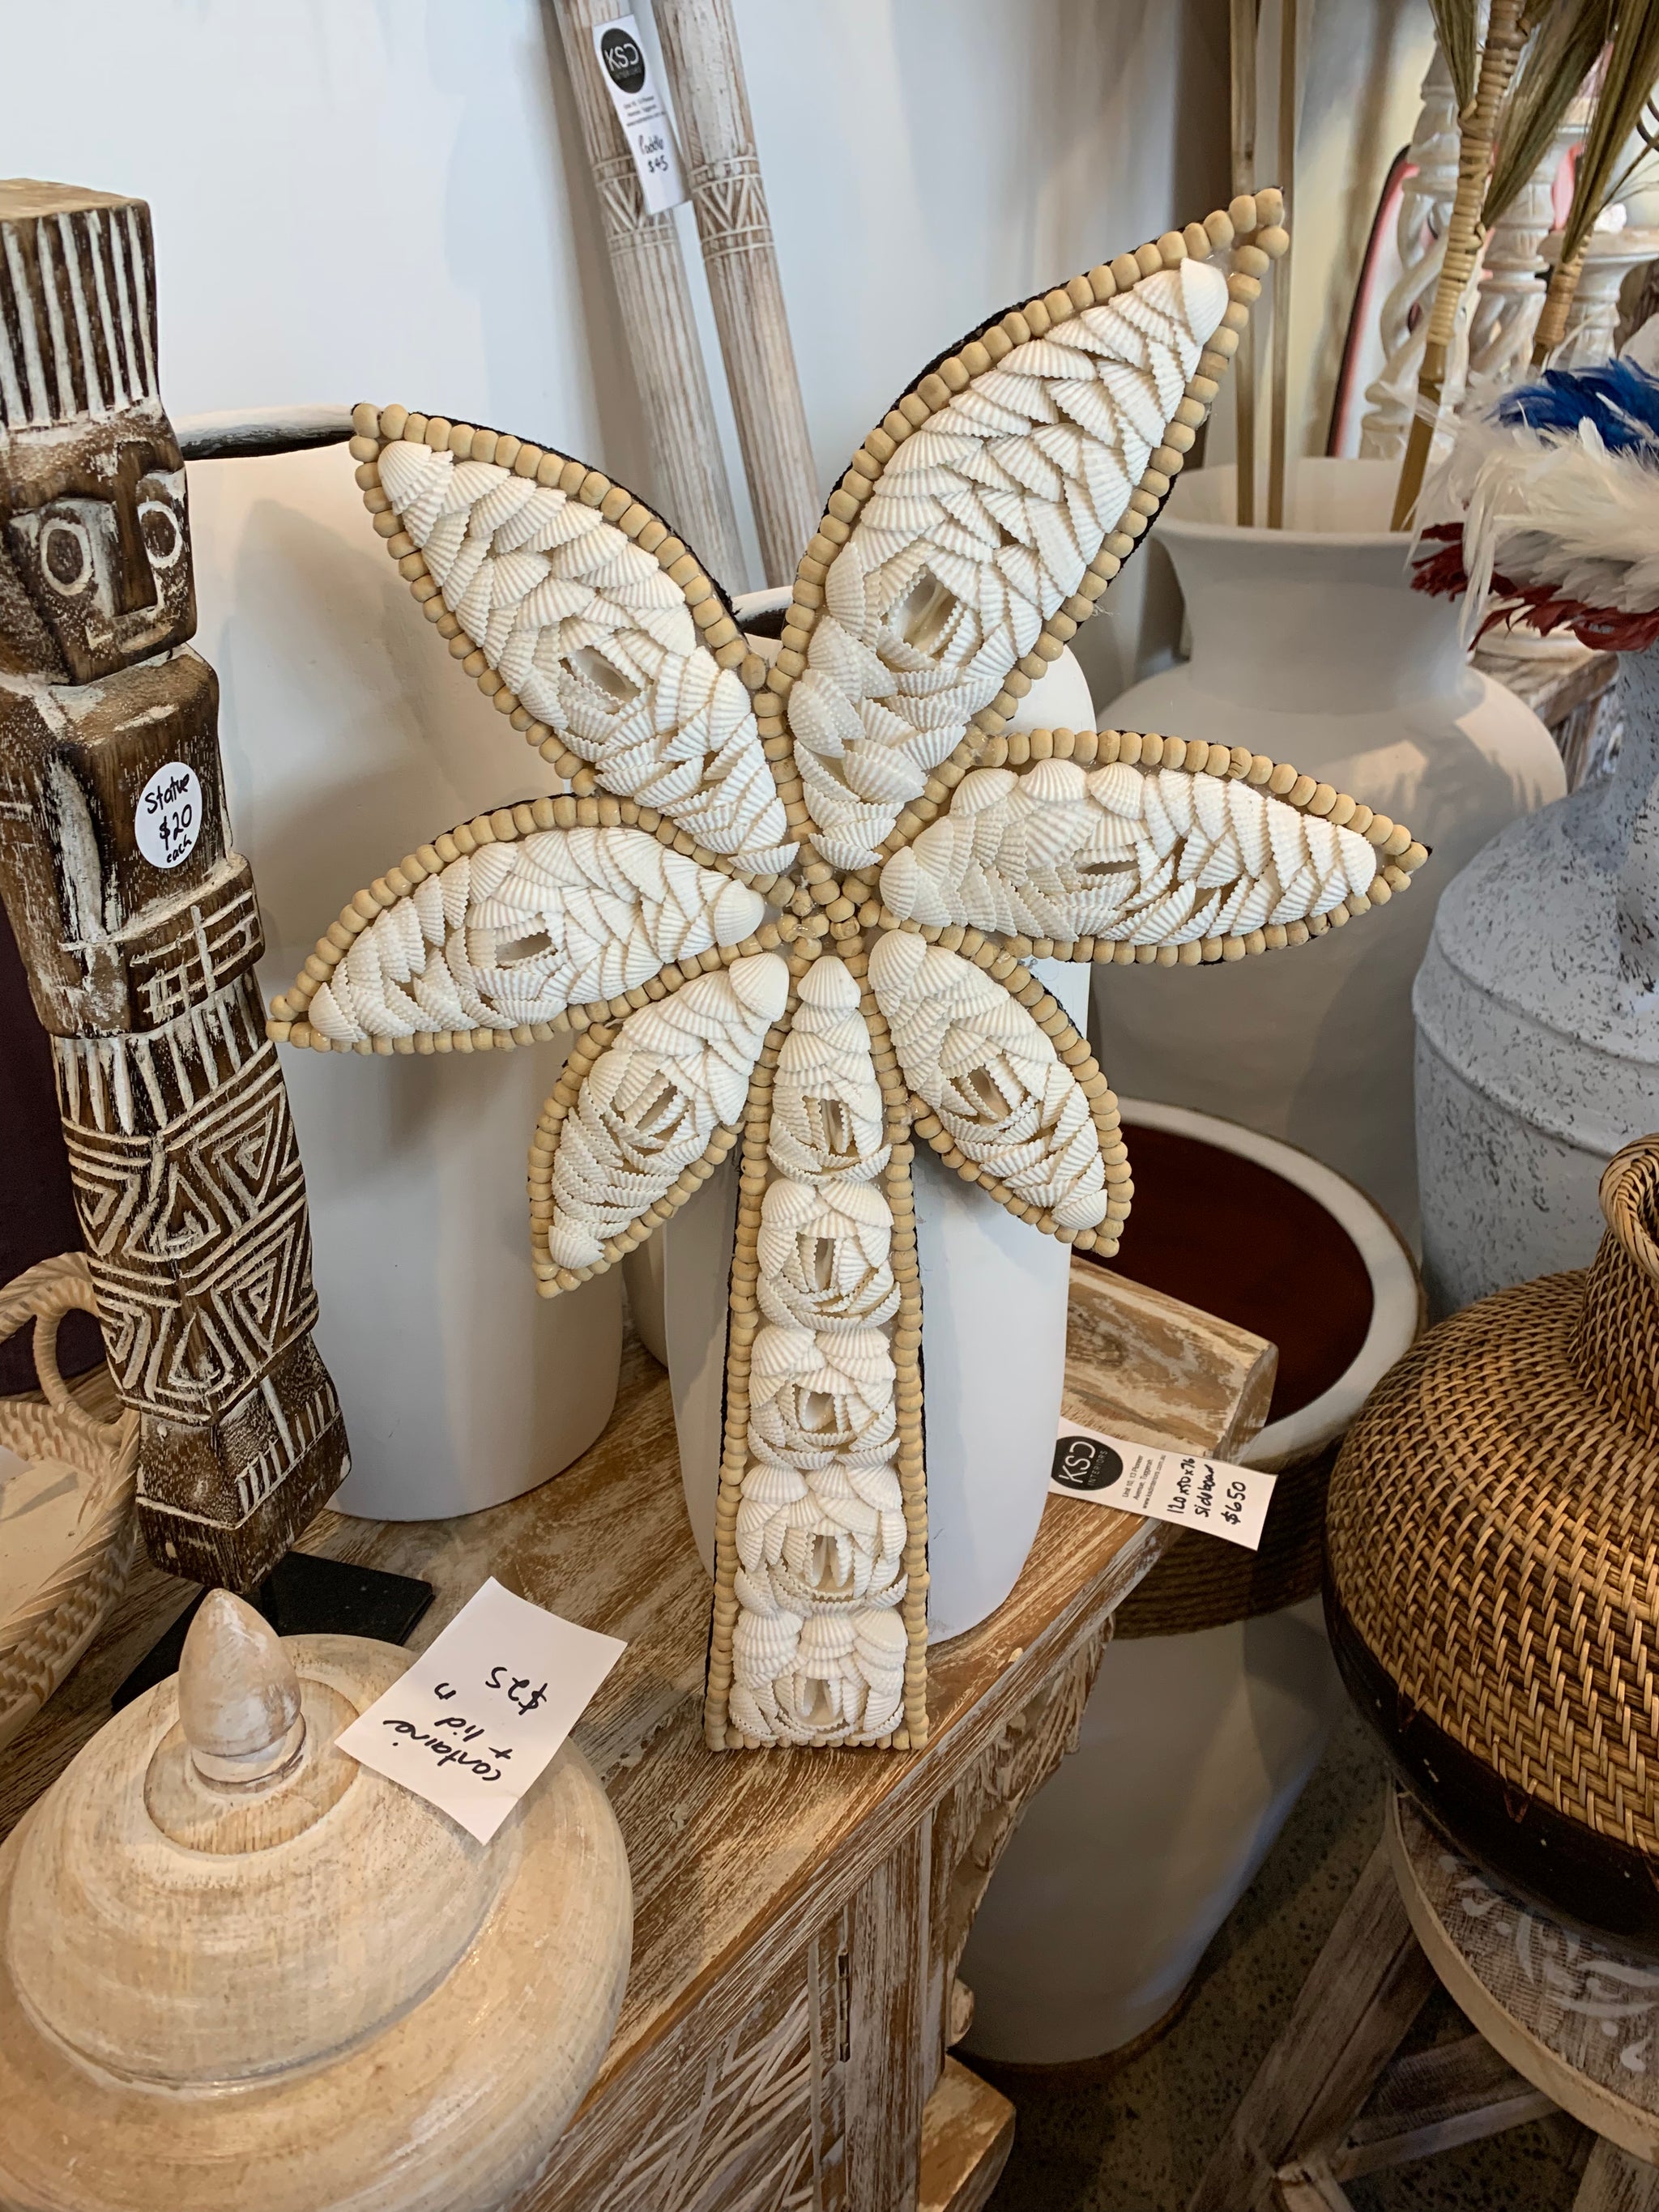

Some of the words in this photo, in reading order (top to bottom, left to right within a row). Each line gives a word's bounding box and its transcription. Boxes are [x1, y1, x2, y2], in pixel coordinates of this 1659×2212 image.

[145, 774, 190, 814] Statue
[160, 804, 192, 850] $20
[166, 834, 192, 863] each
[1058, 1442, 1095, 1484] KSD
[1087, 1450, 1108, 1486] INTERIORS
[1221, 1481, 1246, 1524] $650
[485, 1666, 548, 1716] $25
[434, 1716, 484, 1743] lid
